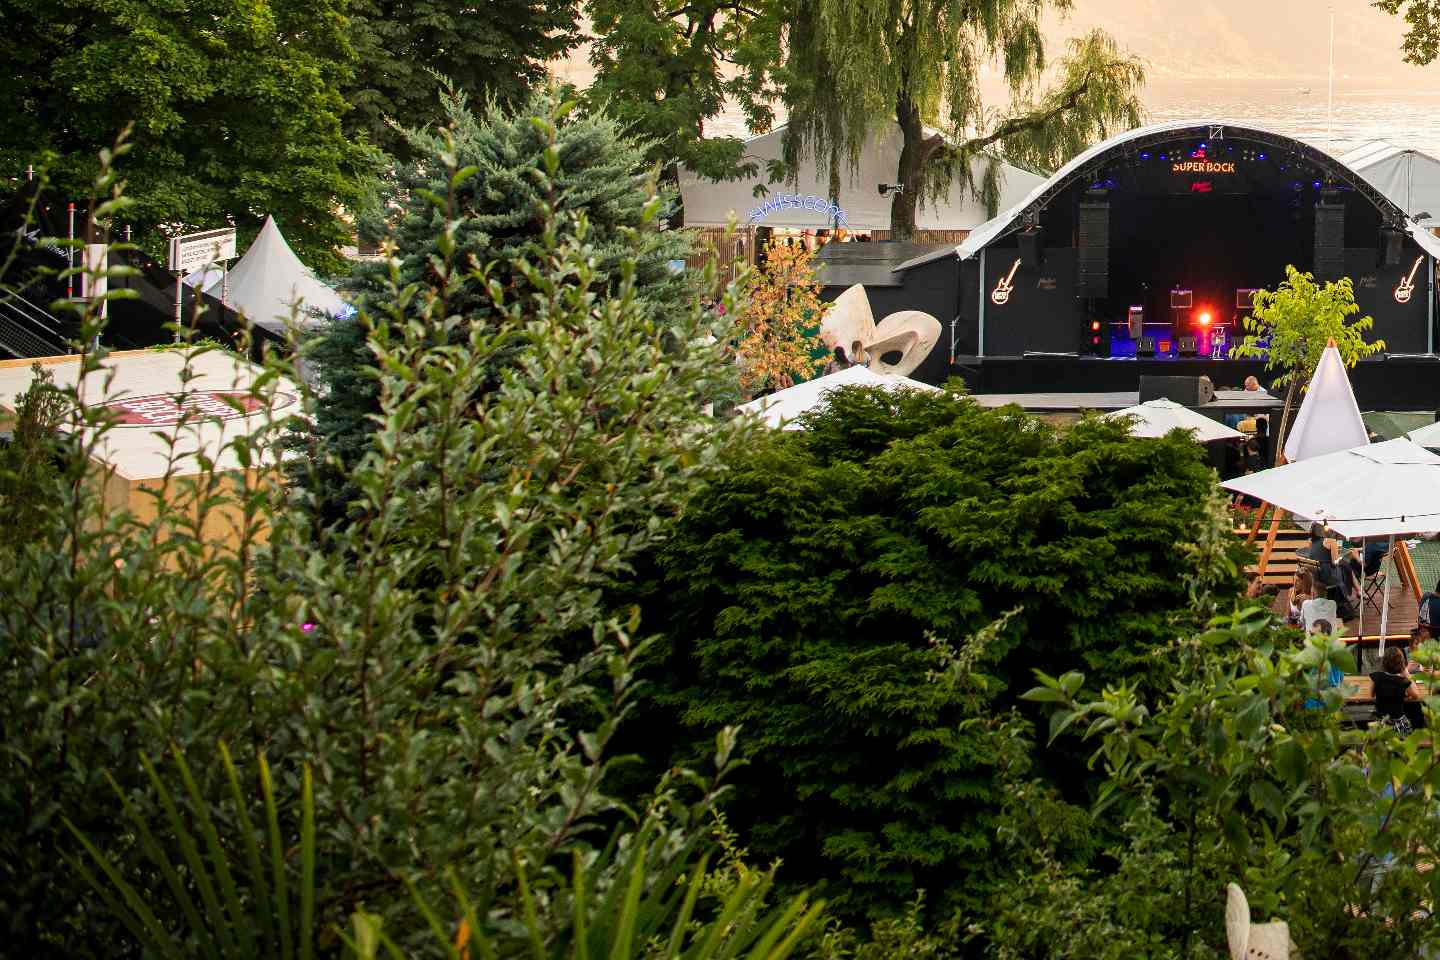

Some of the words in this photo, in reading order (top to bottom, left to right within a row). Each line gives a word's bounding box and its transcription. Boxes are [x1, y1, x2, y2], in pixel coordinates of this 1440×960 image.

[1173, 162, 1205, 172] SUPER
[1206, 162, 1235, 172] BOCK
[746, 192, 848, 227] swisscom
